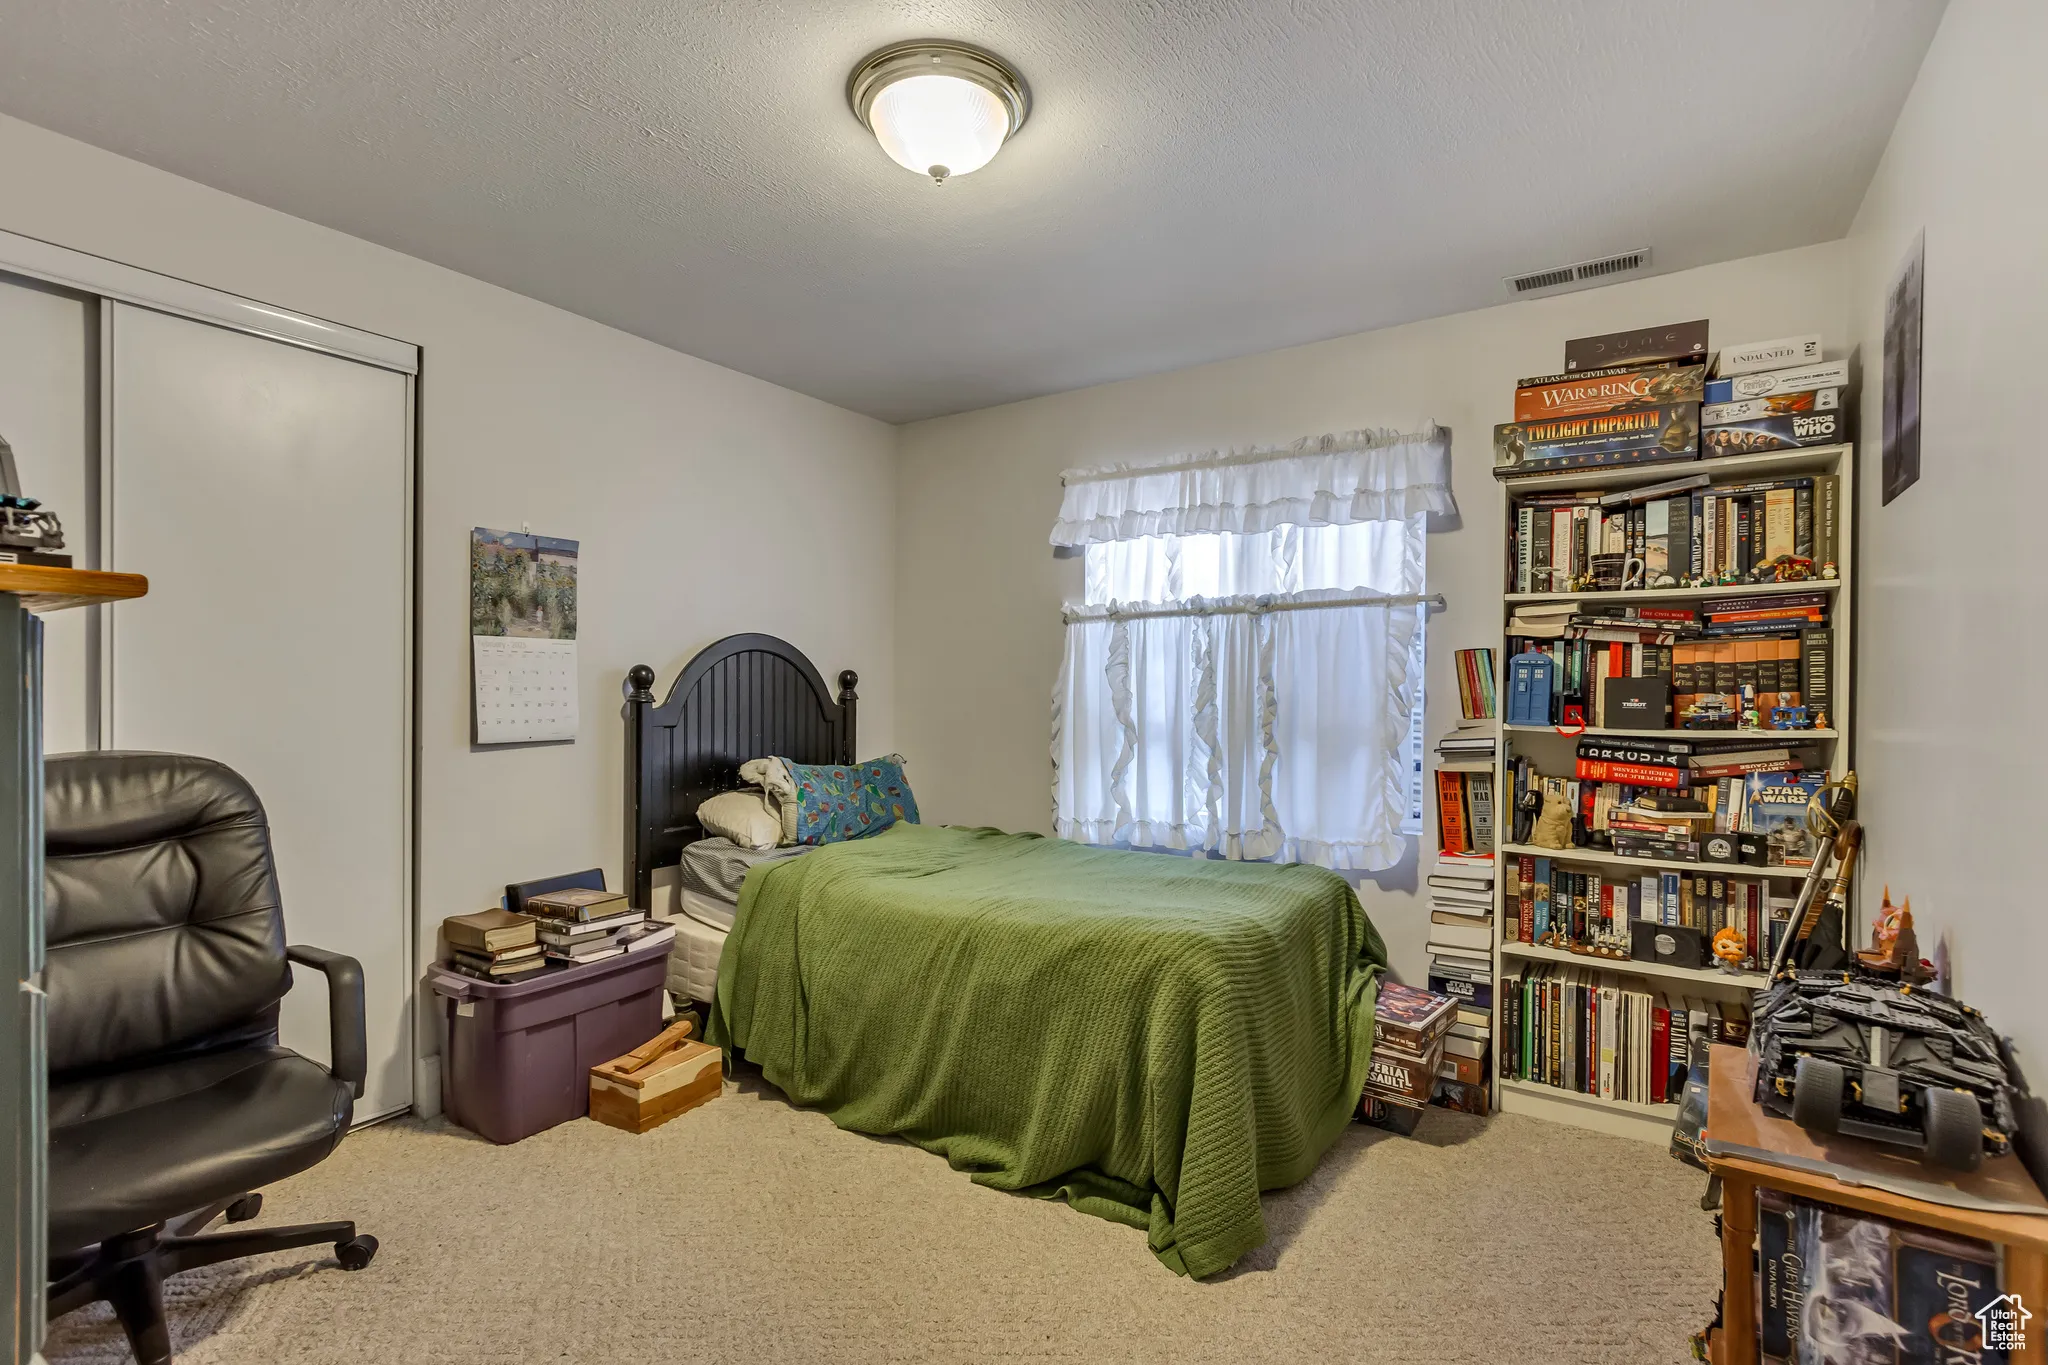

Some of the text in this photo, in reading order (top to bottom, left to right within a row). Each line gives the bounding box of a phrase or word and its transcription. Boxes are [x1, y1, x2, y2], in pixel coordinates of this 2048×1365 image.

[1733, 349, 1794, 363] UNDAUNTED
[1534, 375, 1560, 384] ATLAS
[1580, 369, 1605, 379] CIVIL
[1607, 367, 1627, 376] WAR
[1542, 388, 1585, 407] WAR
[1601, 378, 1650, 397] RING
[1527, 411, 1660, 442] TWILIGHT IMPERIUM
[1793, 415, 1834, 426] DOCTOR
[1793, 422, 1836, 437] WHO
[1754, 509, 1763, 520] the
[1520, 511, 1528, 536] RUSSIA
[1754, 522, 1763, 533] will
[1754, 541, 1762, 554] win
[1692, 545, 1701, 574] CIVIL WAR
[1809, 650, 1826, 698] CHURCHILL
[1589, 748, 1678, 766] DRACULA
[1472, 780, 1488, 790] CIVIL
[1629, 774, 1663, 782] REPUBLIC
[1442, 780, 1457, 791] CIVIL
[1762, 786, 1808, 795] STAR
[1443, 792, 1458, 801] WAR
[1473, 792, 1489, 801] WAR
[1762, 795, 1808, 804] WARS
[1446, 981, 1473, 989] STAR
[1446, 985, 1474, 996] WARS
[1552, 1042, 1560, 1059] AMERICAN
[1670, 1027, 1687, 1066] LINCOLN
[1367, 1072, 1405, 1089] SAULT
[1369, 1062, 1412, 1088] PERIAL
[1769, 1259, 1777, 1309] EXPANSION
[1782, 1239, 1805, 1339] THE GREY HAVENS
